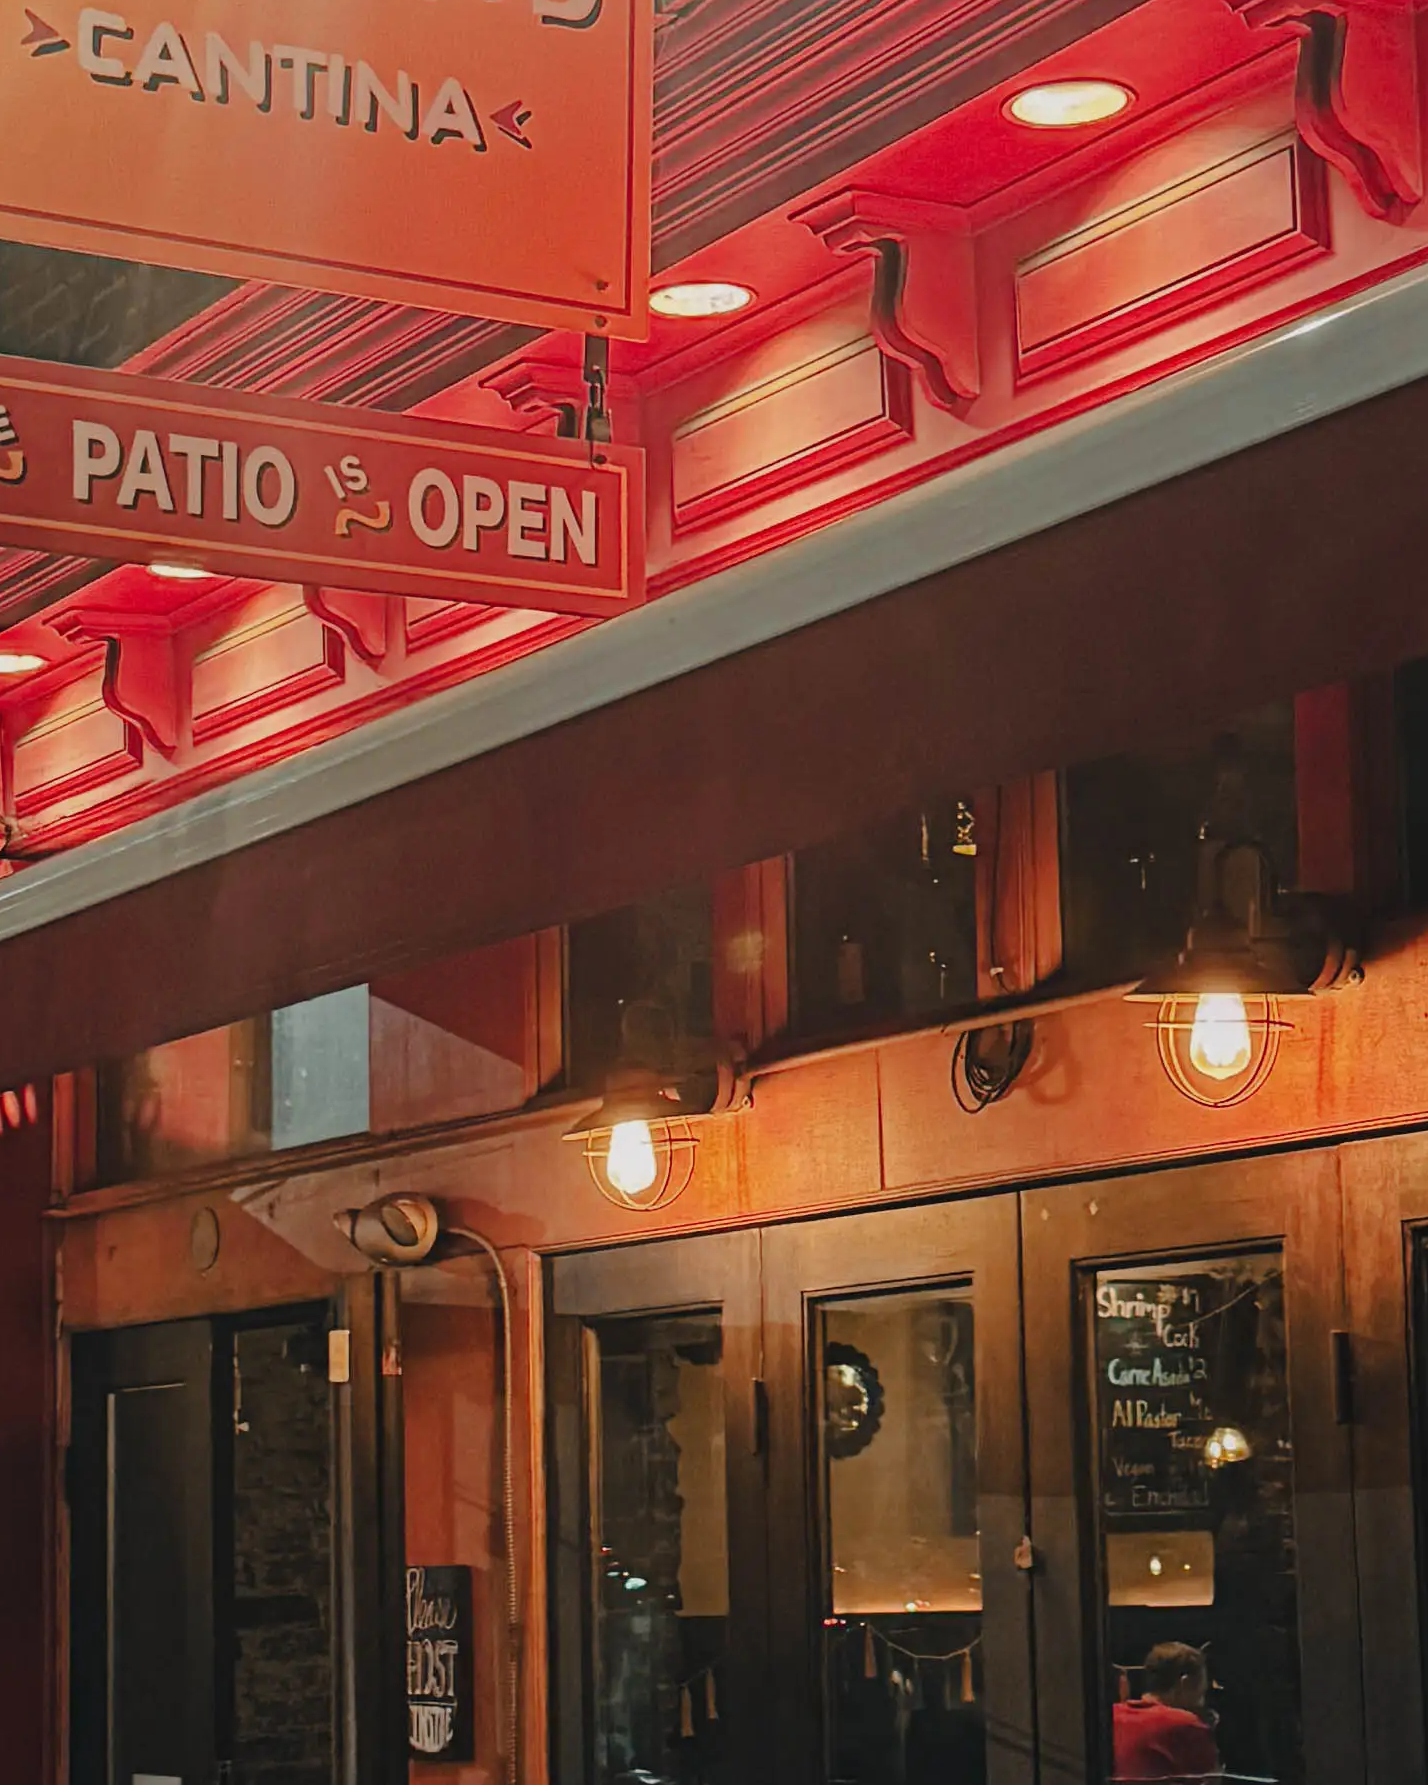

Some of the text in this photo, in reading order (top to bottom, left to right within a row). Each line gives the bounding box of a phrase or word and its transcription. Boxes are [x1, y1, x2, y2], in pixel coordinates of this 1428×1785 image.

[78, 7, 487, 152] CANTINA
[72, 419, 298, 526] PATIO
[323, 454, 370, 501] IS
[407, 467, 598, 566] OPEN
[1096, 1286, 1172, 1337] Shrimp
